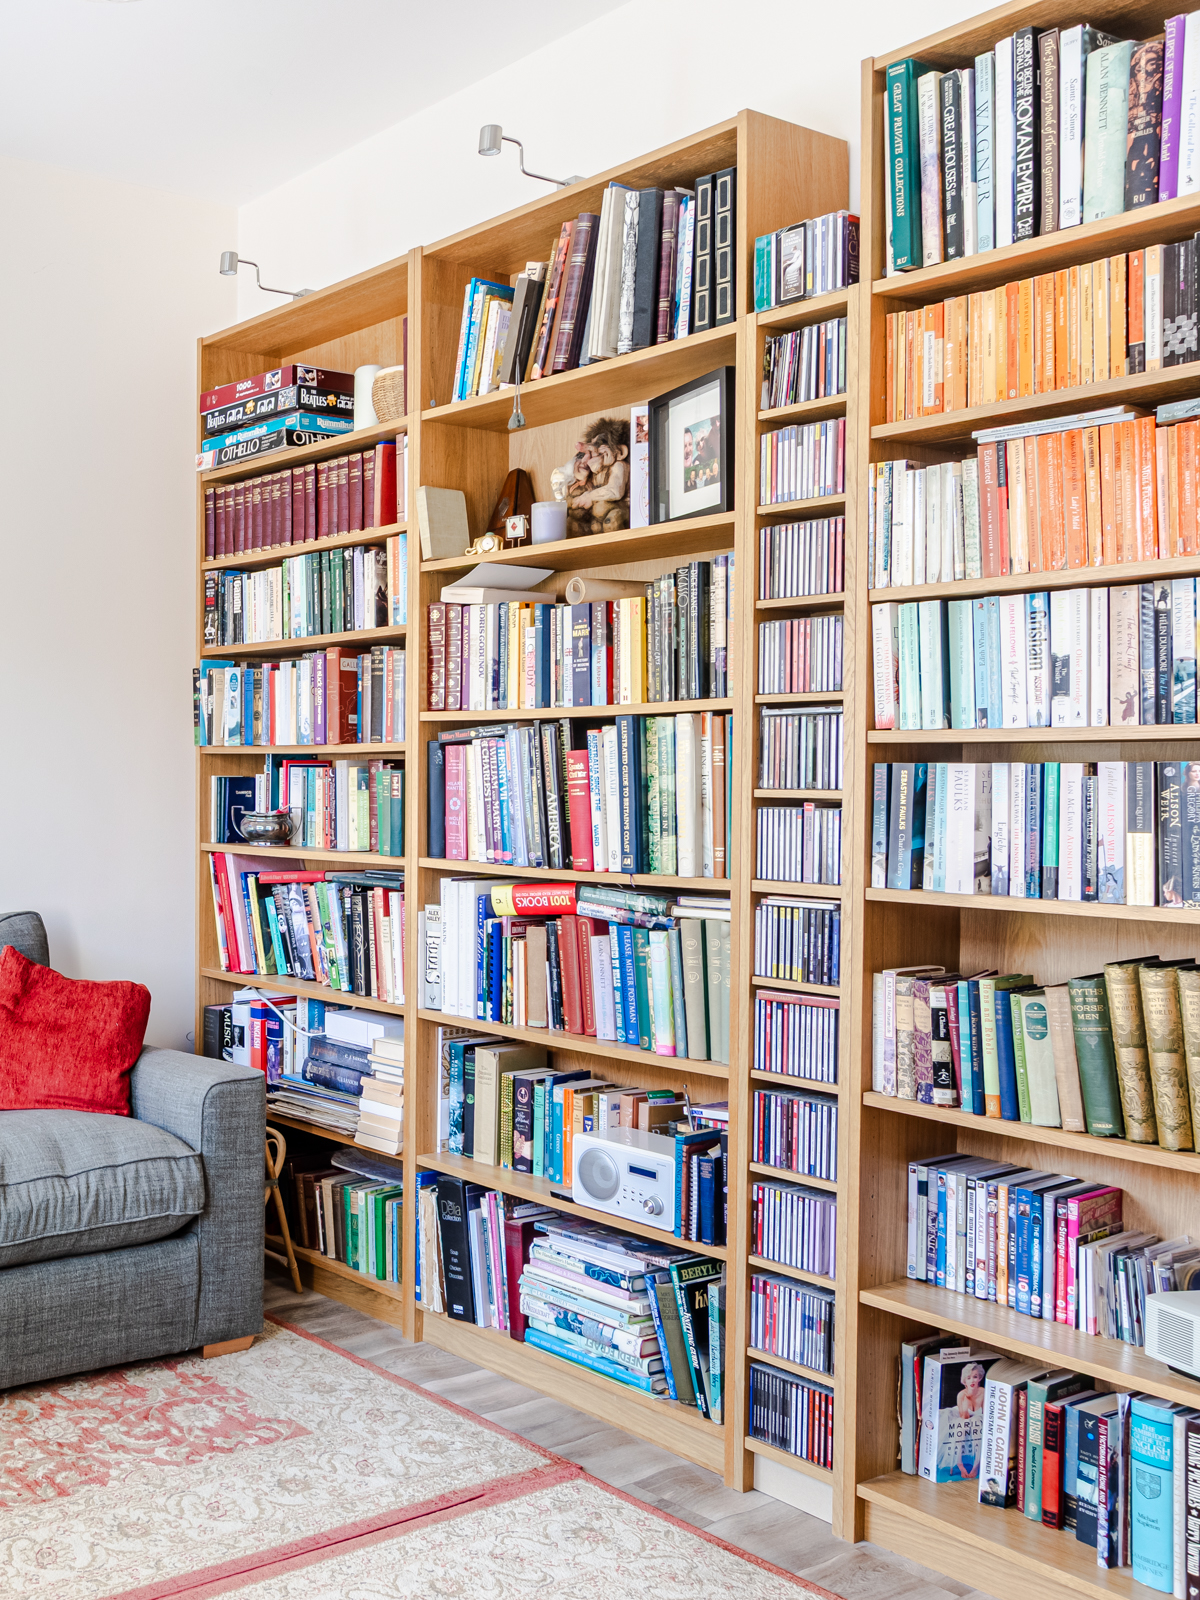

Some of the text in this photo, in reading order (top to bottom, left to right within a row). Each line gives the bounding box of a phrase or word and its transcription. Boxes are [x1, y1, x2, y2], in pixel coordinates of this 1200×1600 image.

[1069, 78, 1078, 141] Saints & Sinners
[893, 82, 905, 217] GREAT PRIVATE COLLECTIONS
[944, 106, 957, 190] GREAT HOUSES
[1042, 38, 1055, 232] The Folio Society Book of The 100 Greatest Portraits
[976, 100, 991, 206] WAGNER
[1016, 96, 1033, 216] ROMAN EMPIRE
[301, 389, 327, 408] BEATLES
[207, 412, 225, 428] BEATLES
[237, 425, 268, 441] Rummikub
[221, 439, 259, 461] OTHELLO
[984, 450, 993, 485] Educated
[1070, 496, 1080, 515] Lady's
[1072, 515, 1080, 530] Maid
[234, 580, 242, 614] Gandhi
[690, 569, 698, 617] DICK FRANCIS
[572, 629, 590, 637] MARR
[876, 646, 884, 669] GOD
[1028, 610, 1048, 705] Grisham ASSOCIATE
[1159, 613, 1168, 695] HELEN DUNMORE The Lie
[314, 658, 323, 706] the black death
[1054, 660, 1062, 684] Whistler
[876, 672, 885, 717] DELUSION
[455, 730, 470, 739] Mantel
[621, 720, 629, 764] ILLUSTRATED
[490, 747, 499, 789] WILLIAM
[498, 748, 506, 784] HENRY
[622, 787, 629, 796] TO
[900, 769, 908, 805] SEBASTIAN
[954, 770, 963, 811] FAULKS
[1105, 767, 1117, 796] Isabella
[492, 801, 501, 829] MARY
[899, 805, 907, 830] FAULKS
[1161, 788, 1170, 821] WEIR
[1169, 783, 1181, 827] ALISON
[1186, 786, 1196, 823] GREGORY
[546, 790, 560, 853] AMERICA
[896, 862, 905, 878] Gray
[516, 895, 571, 907] 1001 BOOKS
[609, 925, 619, 958] SUMMONED
[611, 959, 619, 967] BY
[612, 969, 621, 987] BELLS
[624, 931, 636, 1023] PLEASE, MISTER POSTMAN
[1069, 988, 1104, 997] MYTHS
[982, 984, 994, 1055] Hons and Rebels
[1071, 1004, 1106, 1012] NORSE-
[441, 1200, 461, 1216] Delia
[442, 1214, 462, 1222] Collection
[1058, 1227, 1067, 1257] Stranger
[681, 1262, 715, 1281] BERYL
[584, 1338, 644, 1369] NEEDLECRAFT
[988, 1401, 996, 1436] CONSTANT
[1029, 1401, 1042, 1419] THE
[994, 1388, 1007, 1478] JOHN le CARRÉ
[1028, 1420, 1041, 1445] IRISH
[1134, 1433, 1166, 1447] GUIDE TO
[1142, 1423, 1156, 1432] THE
[985, 1438, 993, 1474] GARDENER
[1137, 1512, 1158, 1525] Michael
[1134, 1561, 1163, 1577] NEWNES
